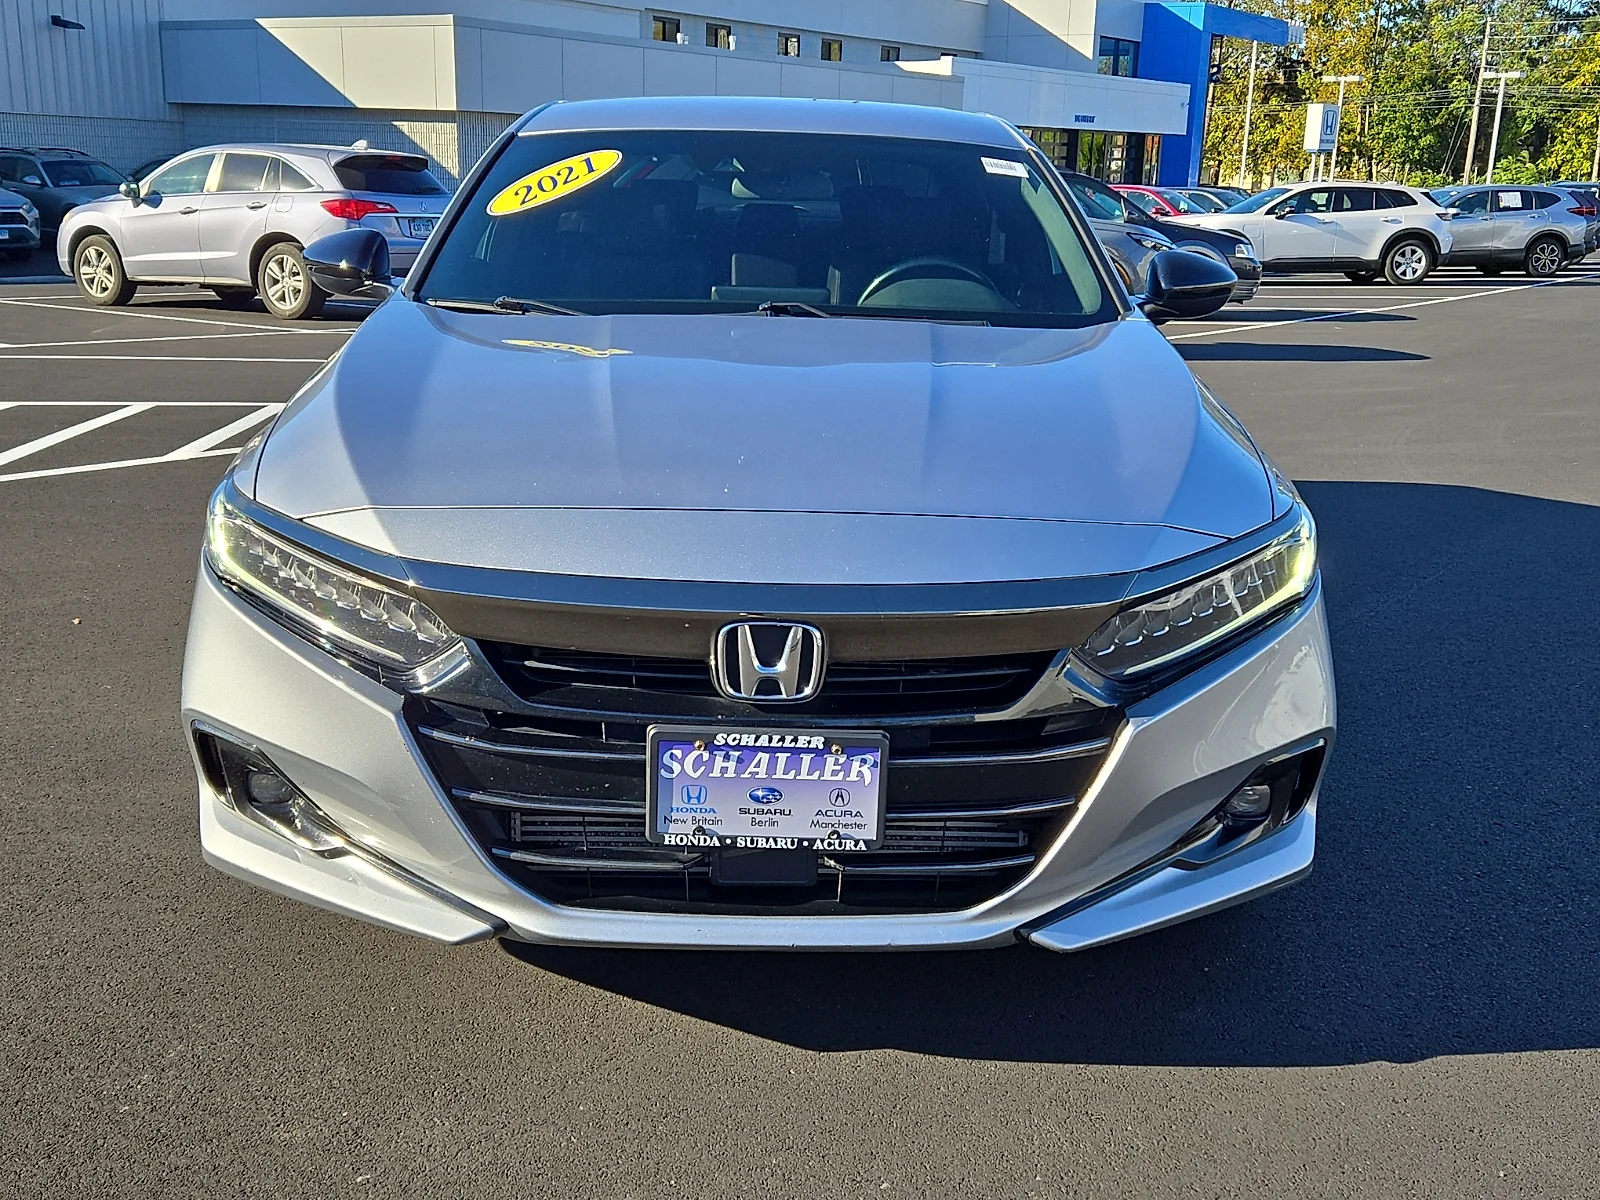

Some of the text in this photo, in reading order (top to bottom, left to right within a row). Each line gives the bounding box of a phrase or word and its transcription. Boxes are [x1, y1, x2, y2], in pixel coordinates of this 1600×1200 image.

[514, 156, 599, 206] 2021
[714, 732, 825, 749] SCHALLER
[660, 749, 875, 787] SCHALLER
[669, 806, 717, 814] HONDA
[738, 807, 792, 816] SUBARU
[814, 809, 864, 818] ACURA
[663, 815, 723, 826] New Britain
[750, 816, 779, 828] Berlin
[809, 819, 868, 830] Manchester
[663, 834, 867, 851] HONDA SUBARU ACURA
